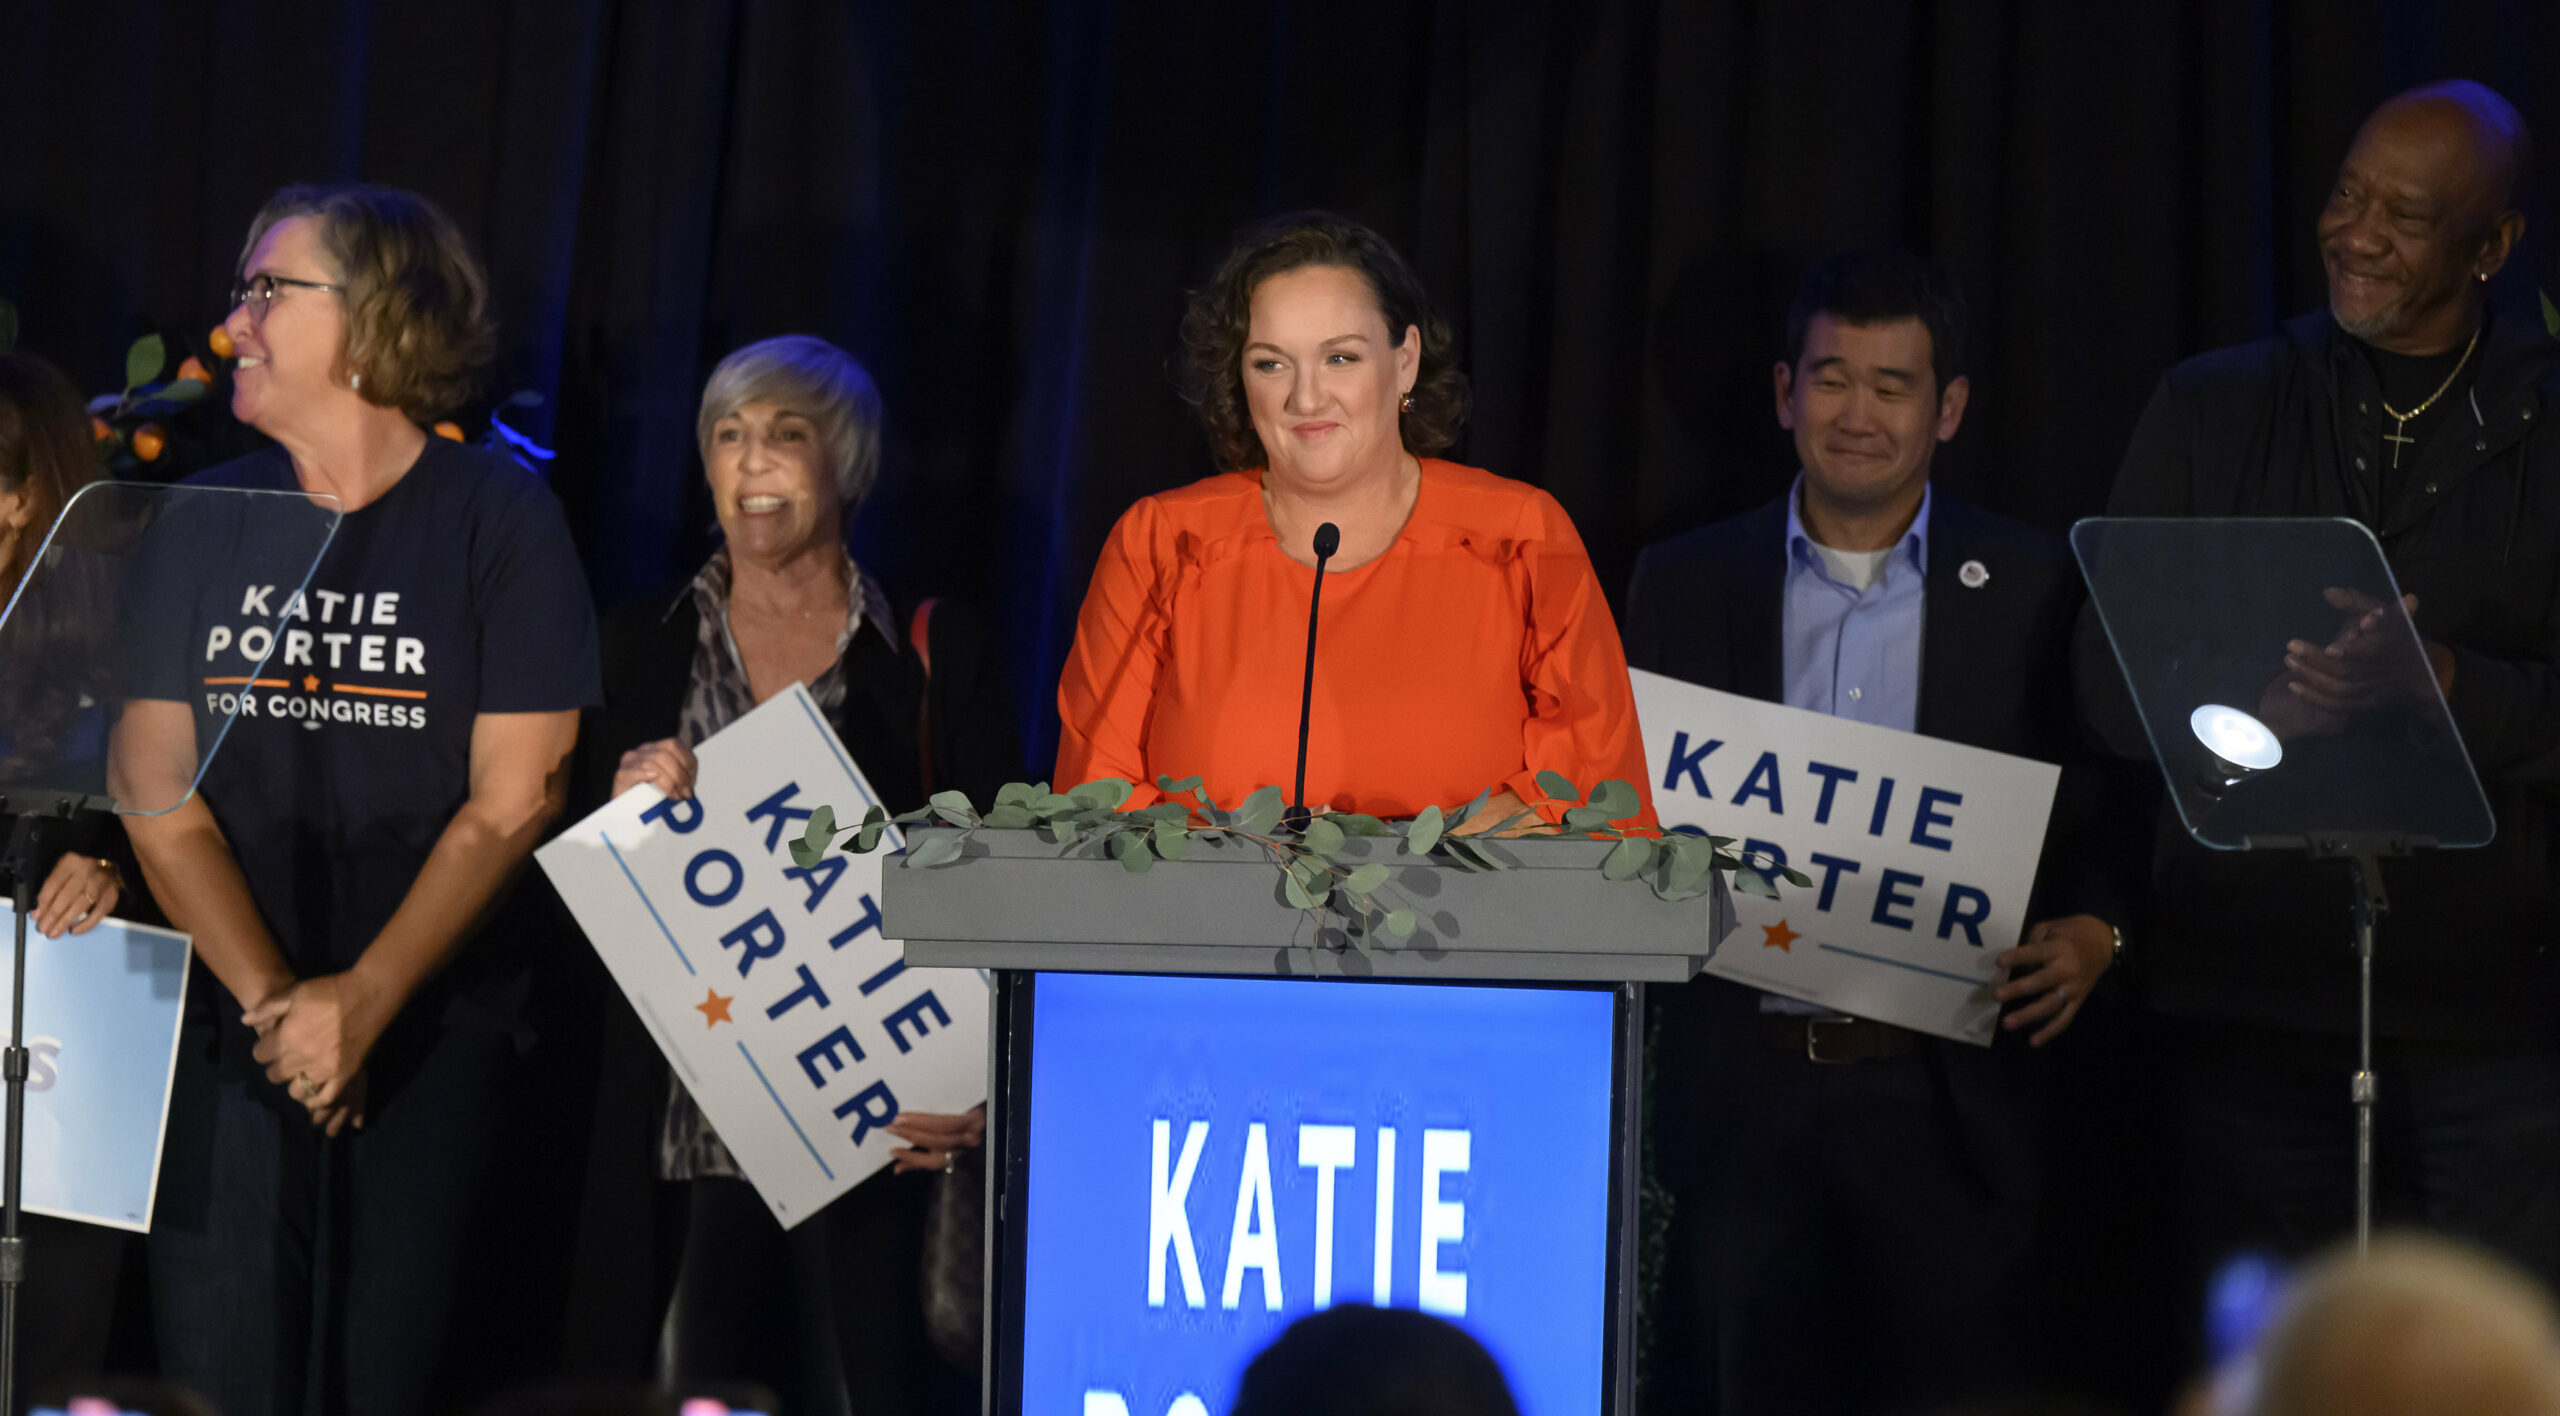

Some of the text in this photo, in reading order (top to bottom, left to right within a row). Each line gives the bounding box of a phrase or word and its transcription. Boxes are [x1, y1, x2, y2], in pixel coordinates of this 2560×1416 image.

[206, 625, 426, 675] PORTER
[241, 584, 400, 625] KATIE
[206, 692, 426, 730] FOR CONGRESS
[1663, 731, 1963, 852] KATIE
[746, 781, 952, 1054] KATIE
[1668, 824, 1991, 947] RTER
[639, 795, 901, 1147] PORTER
[1148, 1118, 1471, 1318] KATIE
